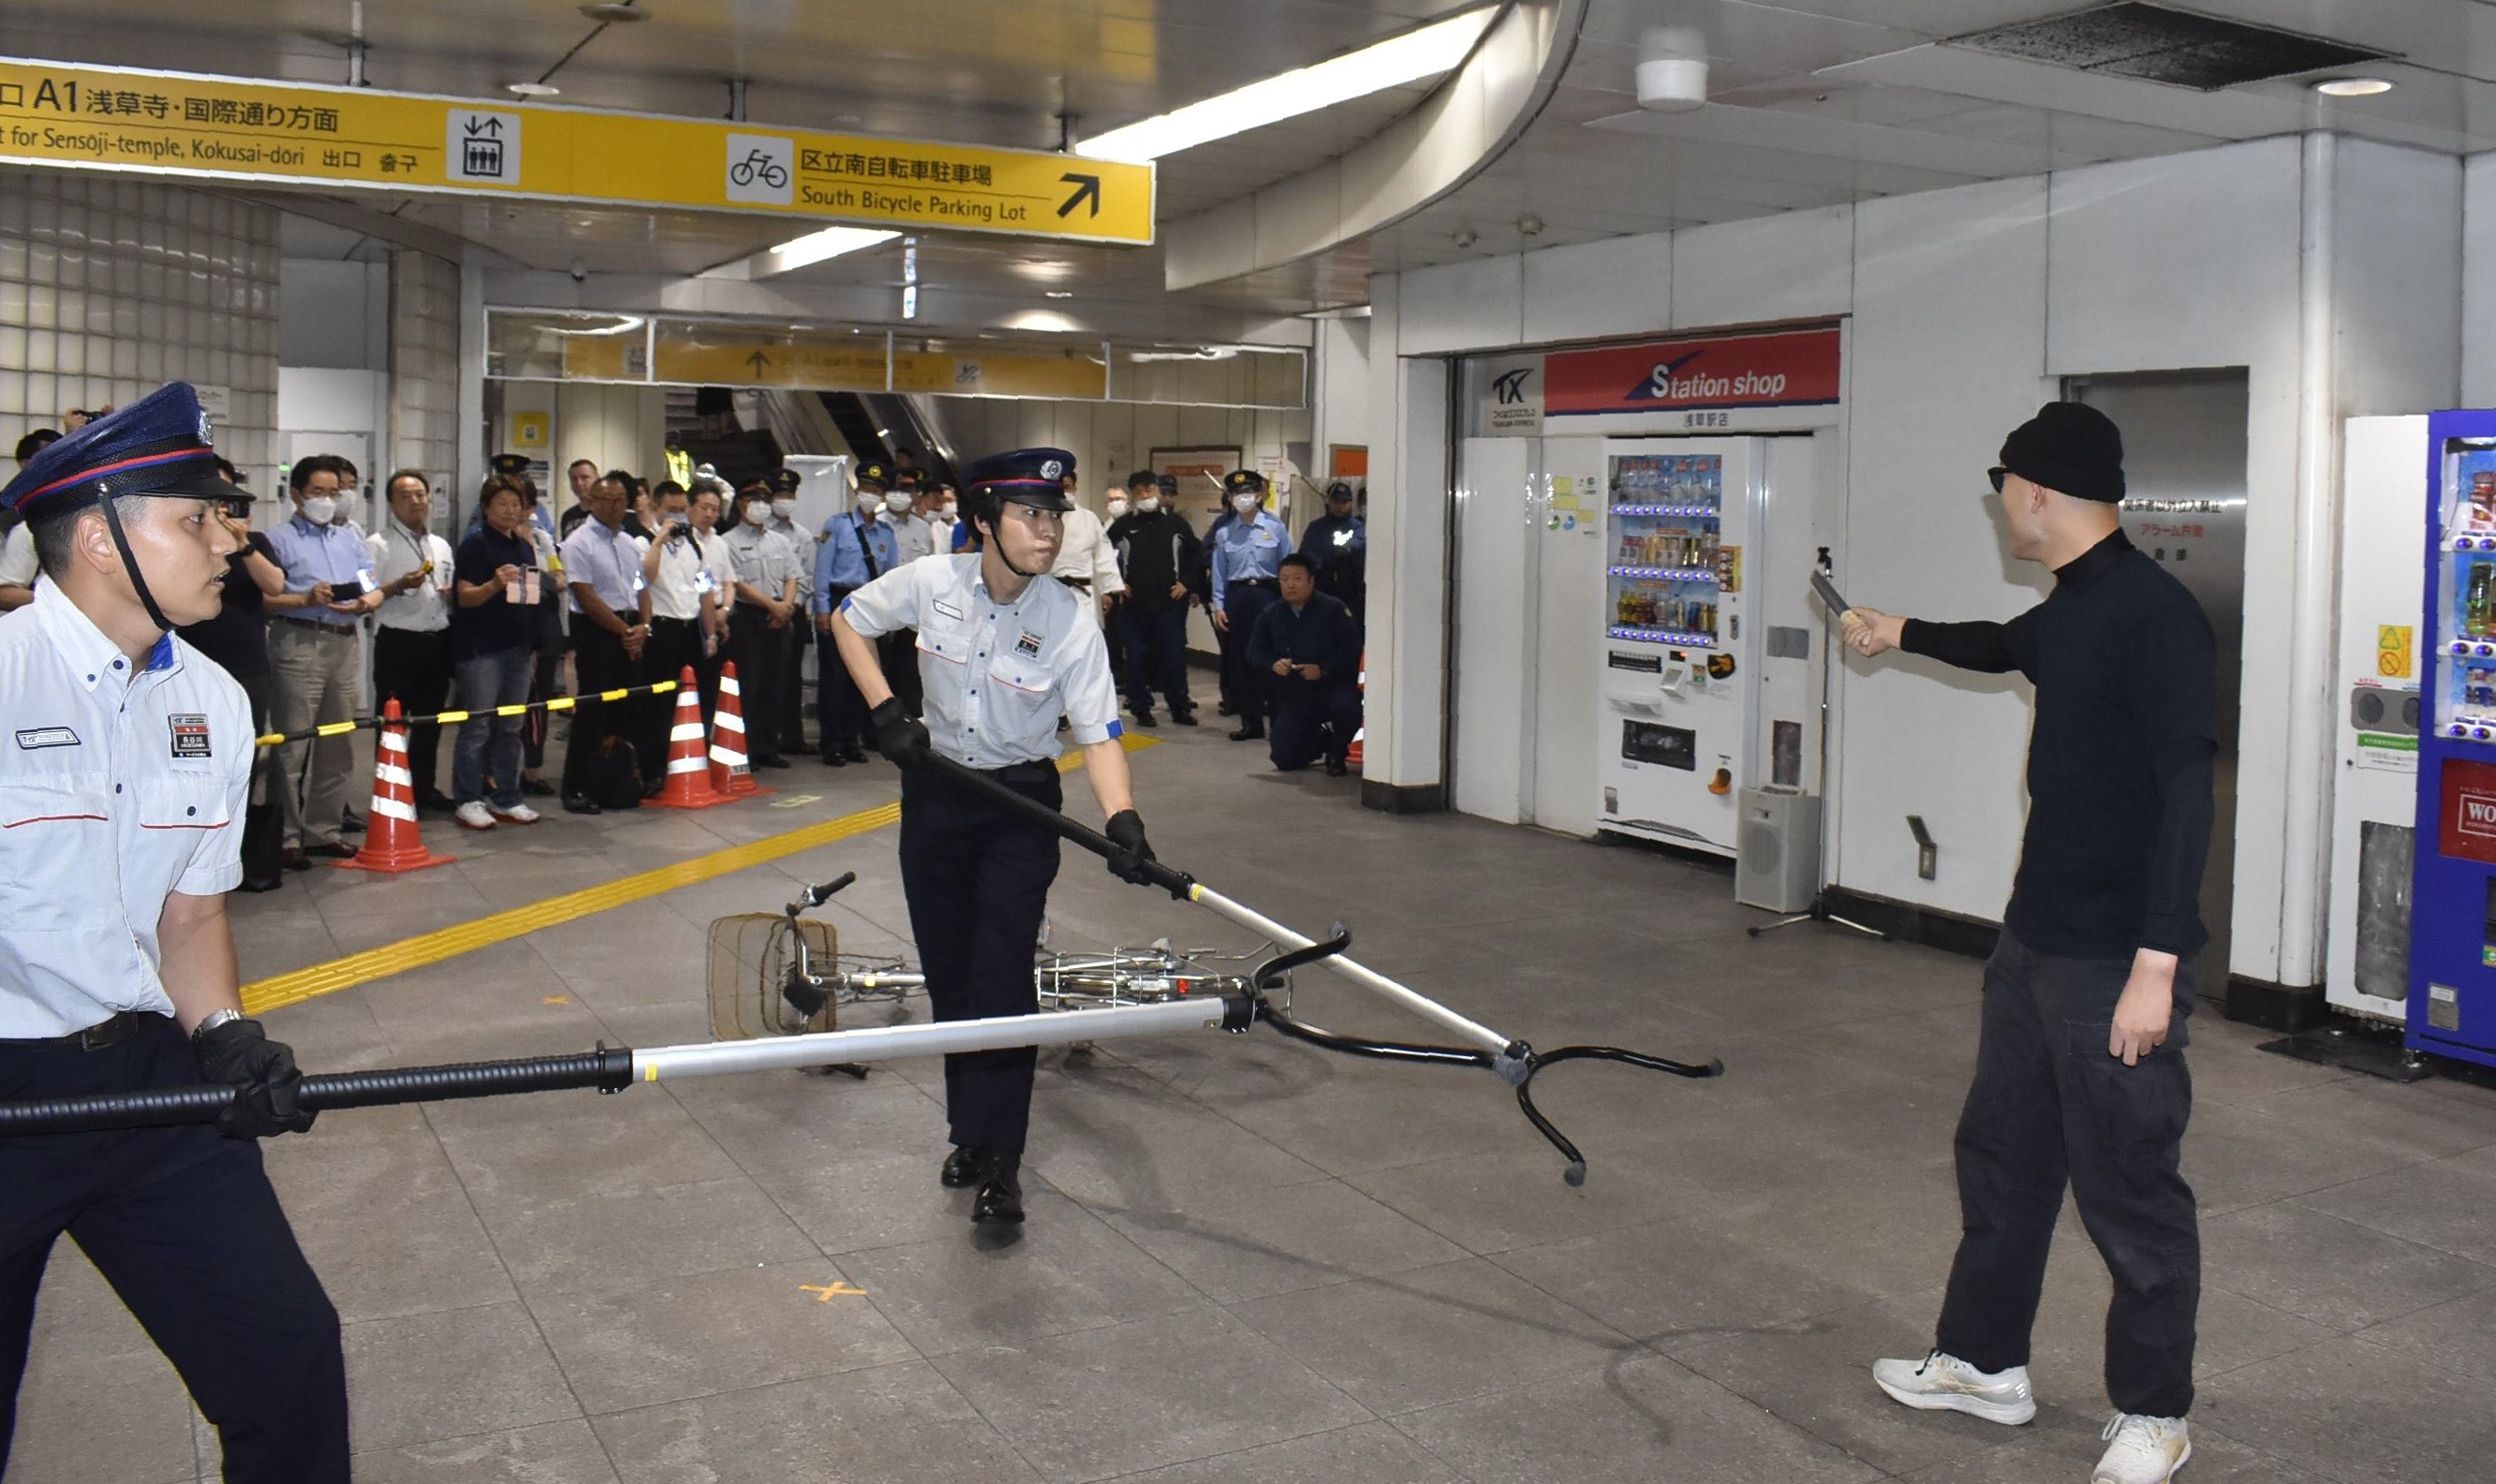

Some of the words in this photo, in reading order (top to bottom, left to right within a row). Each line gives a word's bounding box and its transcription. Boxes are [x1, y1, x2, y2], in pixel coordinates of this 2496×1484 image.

[34, 78, 77, 112] A1
[86, 88, 339, 133] 浅草寺・国際通り方面
[11, 125, 38, 146] for
[322, 149, 361, 169] 出口
[801, 148, 992, 187] 区立南自転車駐車場
[802, 185, 854, 207] South
[862, 190, 923, 214] Bicycle
[930, 195, 993, 223] Parking
[999, 201, 1027, 221] Lot
[1492, 367, 1535, 405] TX
[1651, 363, 1730, 400] Station
[1733, 370, 1787, 398] shop
